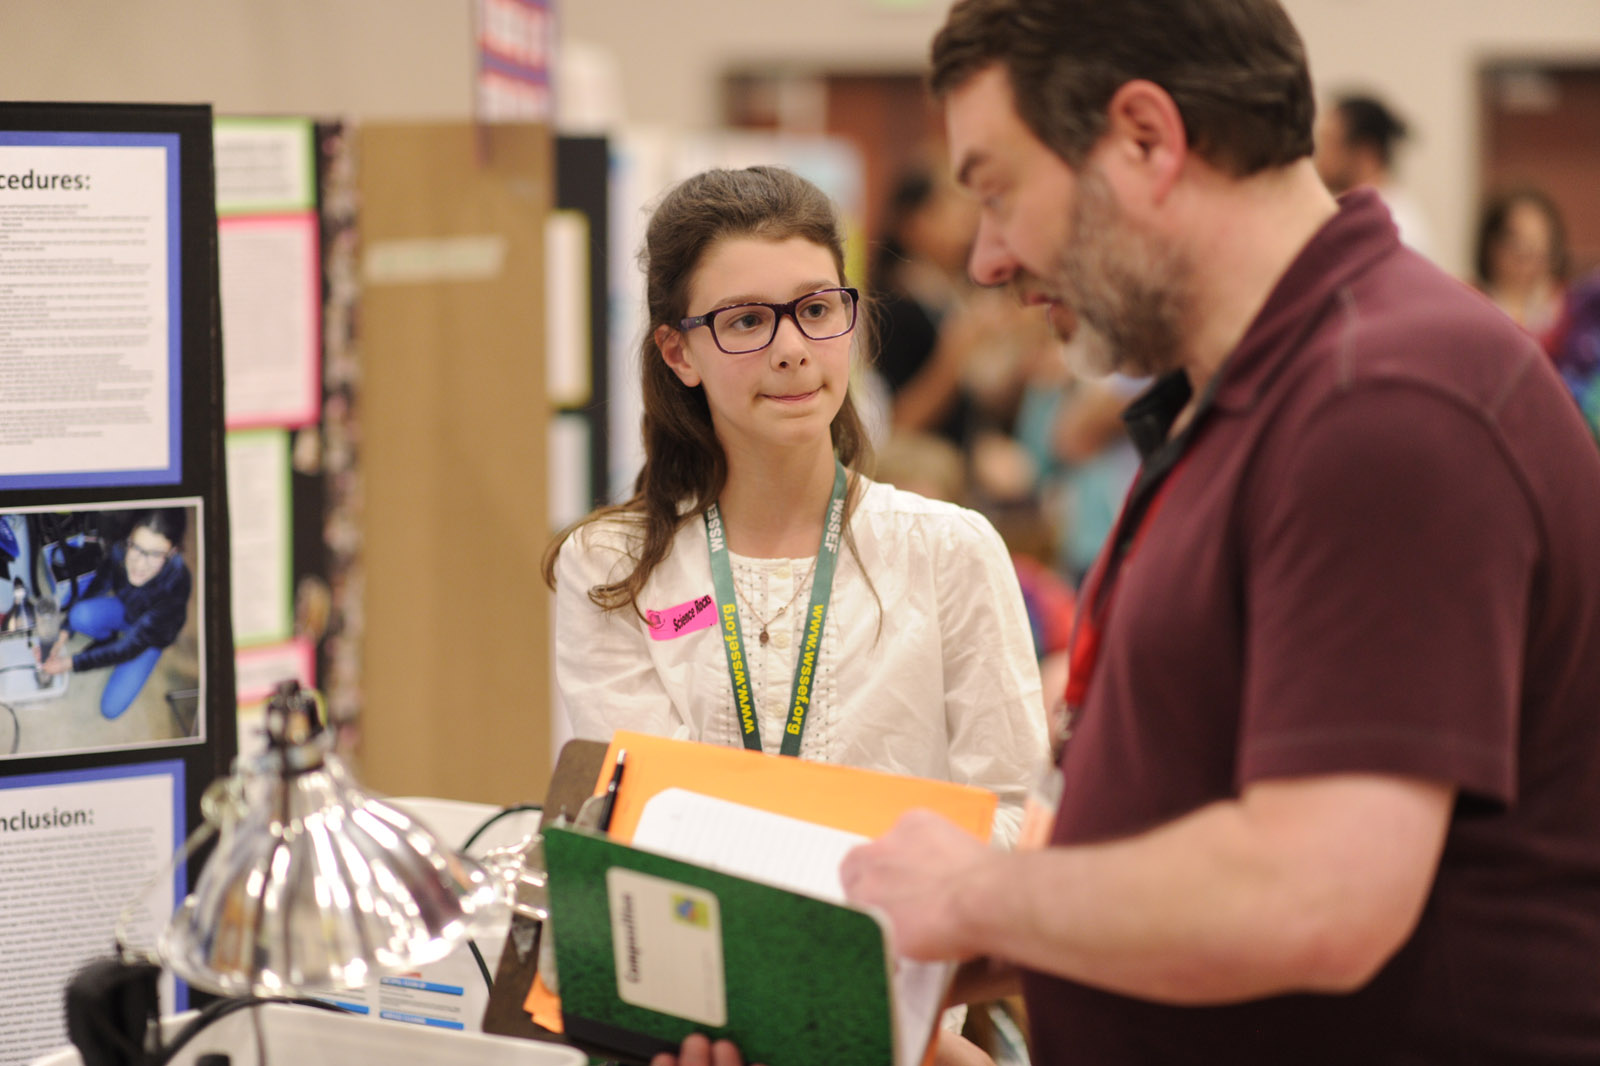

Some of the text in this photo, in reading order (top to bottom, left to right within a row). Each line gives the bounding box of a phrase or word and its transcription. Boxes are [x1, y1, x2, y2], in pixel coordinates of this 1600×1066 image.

[824, 499, 845, 554] WSSEF
[673, 607, 696, 632] Science
[722, 603, 755, 734] www.wssef.org
[787, 604, 824, 735] www.wssef.org
